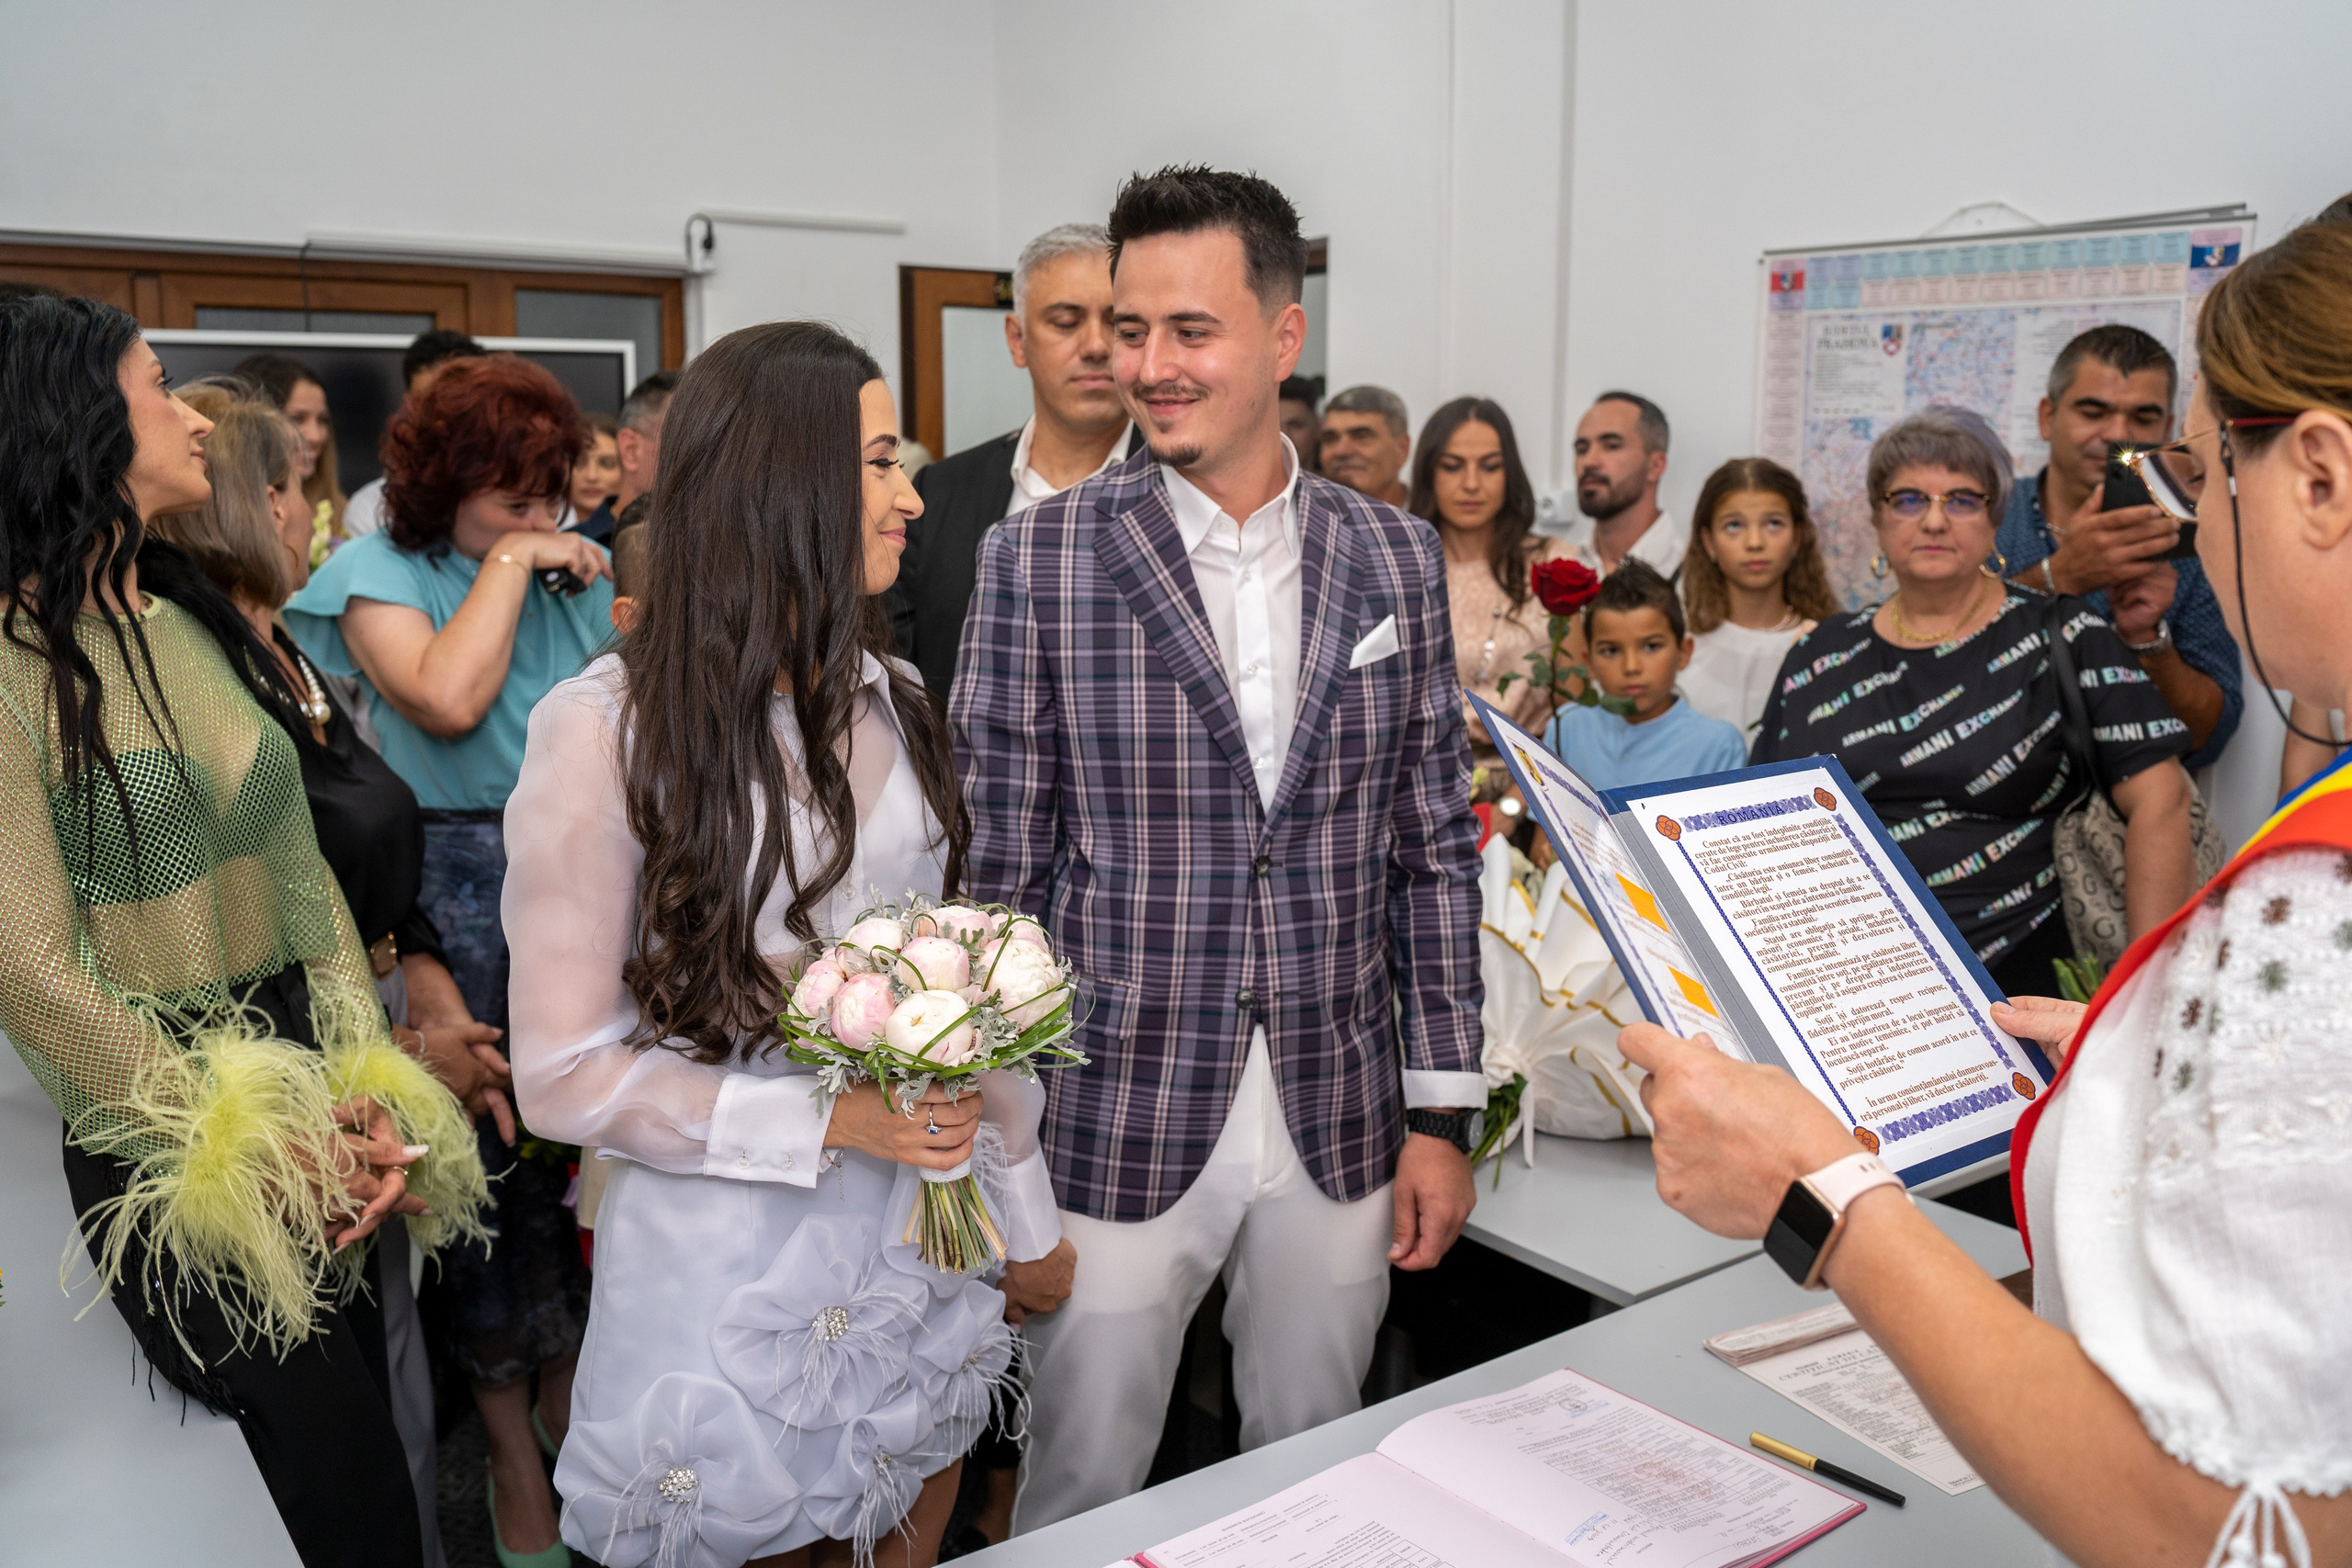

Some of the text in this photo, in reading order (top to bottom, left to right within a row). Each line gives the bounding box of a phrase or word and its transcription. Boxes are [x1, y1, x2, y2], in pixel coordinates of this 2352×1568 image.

[1986, 632, 2041, 674] ARMANI
[1899, 689, 2023, 768] ARMANI EXCHANGE
[1964, 754, 2017, 796] ARMANI
[1695, 850, 1718, 859] cerute
[1742, 841, 1766, 851] pentru
[1702, 838, 1731, 848] Constat
[1704, 861, 1747, 874] Codul Civil:
[1723, 851, 1758, 862] cunoscute
[1777, 862, 1804, 871] uniunea
[1792, 867, 1818, 876] femeie,
[1753, 886, 1772, 894] legii.
[1770, 900, 1792, 910] scopul
[1838, 885, 1865, 894] familie.
[1782, 889, 1807, 898] femeia
[1820, 879, 1845, 890] dreptul
[1752, 916, 1781, 926] Familia
[1792, 906, 1817, 917] dreptul
[1825, 899, 1850, 909] ocrotire
[1861, 892, 1883, 902] partea
[1763, 934, 1787, 945] Statul
[1849, 914, 1878, 924] sprijine,
[1879, 908, 1894, 918] prin
[1787, 936, 1824, 949] economice
[1838, 926, 1864, 936] sociale,
[1807, 942, 1837, 954] precum
[1852, 928, 1894, 941] dezvoltarea
[1767, 950, 1840, 973] consolidarea familiei.
[1861, 958, 1894, 971] egalitatea
[1894, 951, 1924, 962] acestora,
[1786, 969, 1815, 980] Familia
[1840, 985, 1867, 996] asigura
[1904, 966, 1934, 977] educarea
[1784, 989, 1815, 1003] precum
[1846, 972, 1873, 984] dreptul
[1889, 992, 1914, 1004] respect
[1917, 985, 1947, 996] reciproc,
[1795, 1006, 1823, 1018] copiilor
[1807, 1008, 1894, 1038] fidelitate sprijin moral.
[1820, 1047, 1847, 1058] Pentru
[1849, 1039, 1873, 1050] motive
[1875, 1028, 1911, 1042] temeinice,
[1921, 1020, 1933, 1030] pot
[1827, 1037, 1838, 1045] Ei
[1906, 1011, 1926, 1021] locui
[1860, 1044, 1889, 1057] separat.
[1907, 1044, 1931, 1055] comun
[1931, 1036, 1951, 1048] acord
[1959, 1031, 1970, 1039] tot
[1866, 1098, 1878, 1107] În
[1877, 1094, 1898, 1104] urma
[1957, 1061, 1997, 1077] dumneavoas-
[1871, 1101, 1904, 1119] personal
[1906, 1095, 1928, 1105] liber,
[1935, 1085, 1955, 1096] declar
